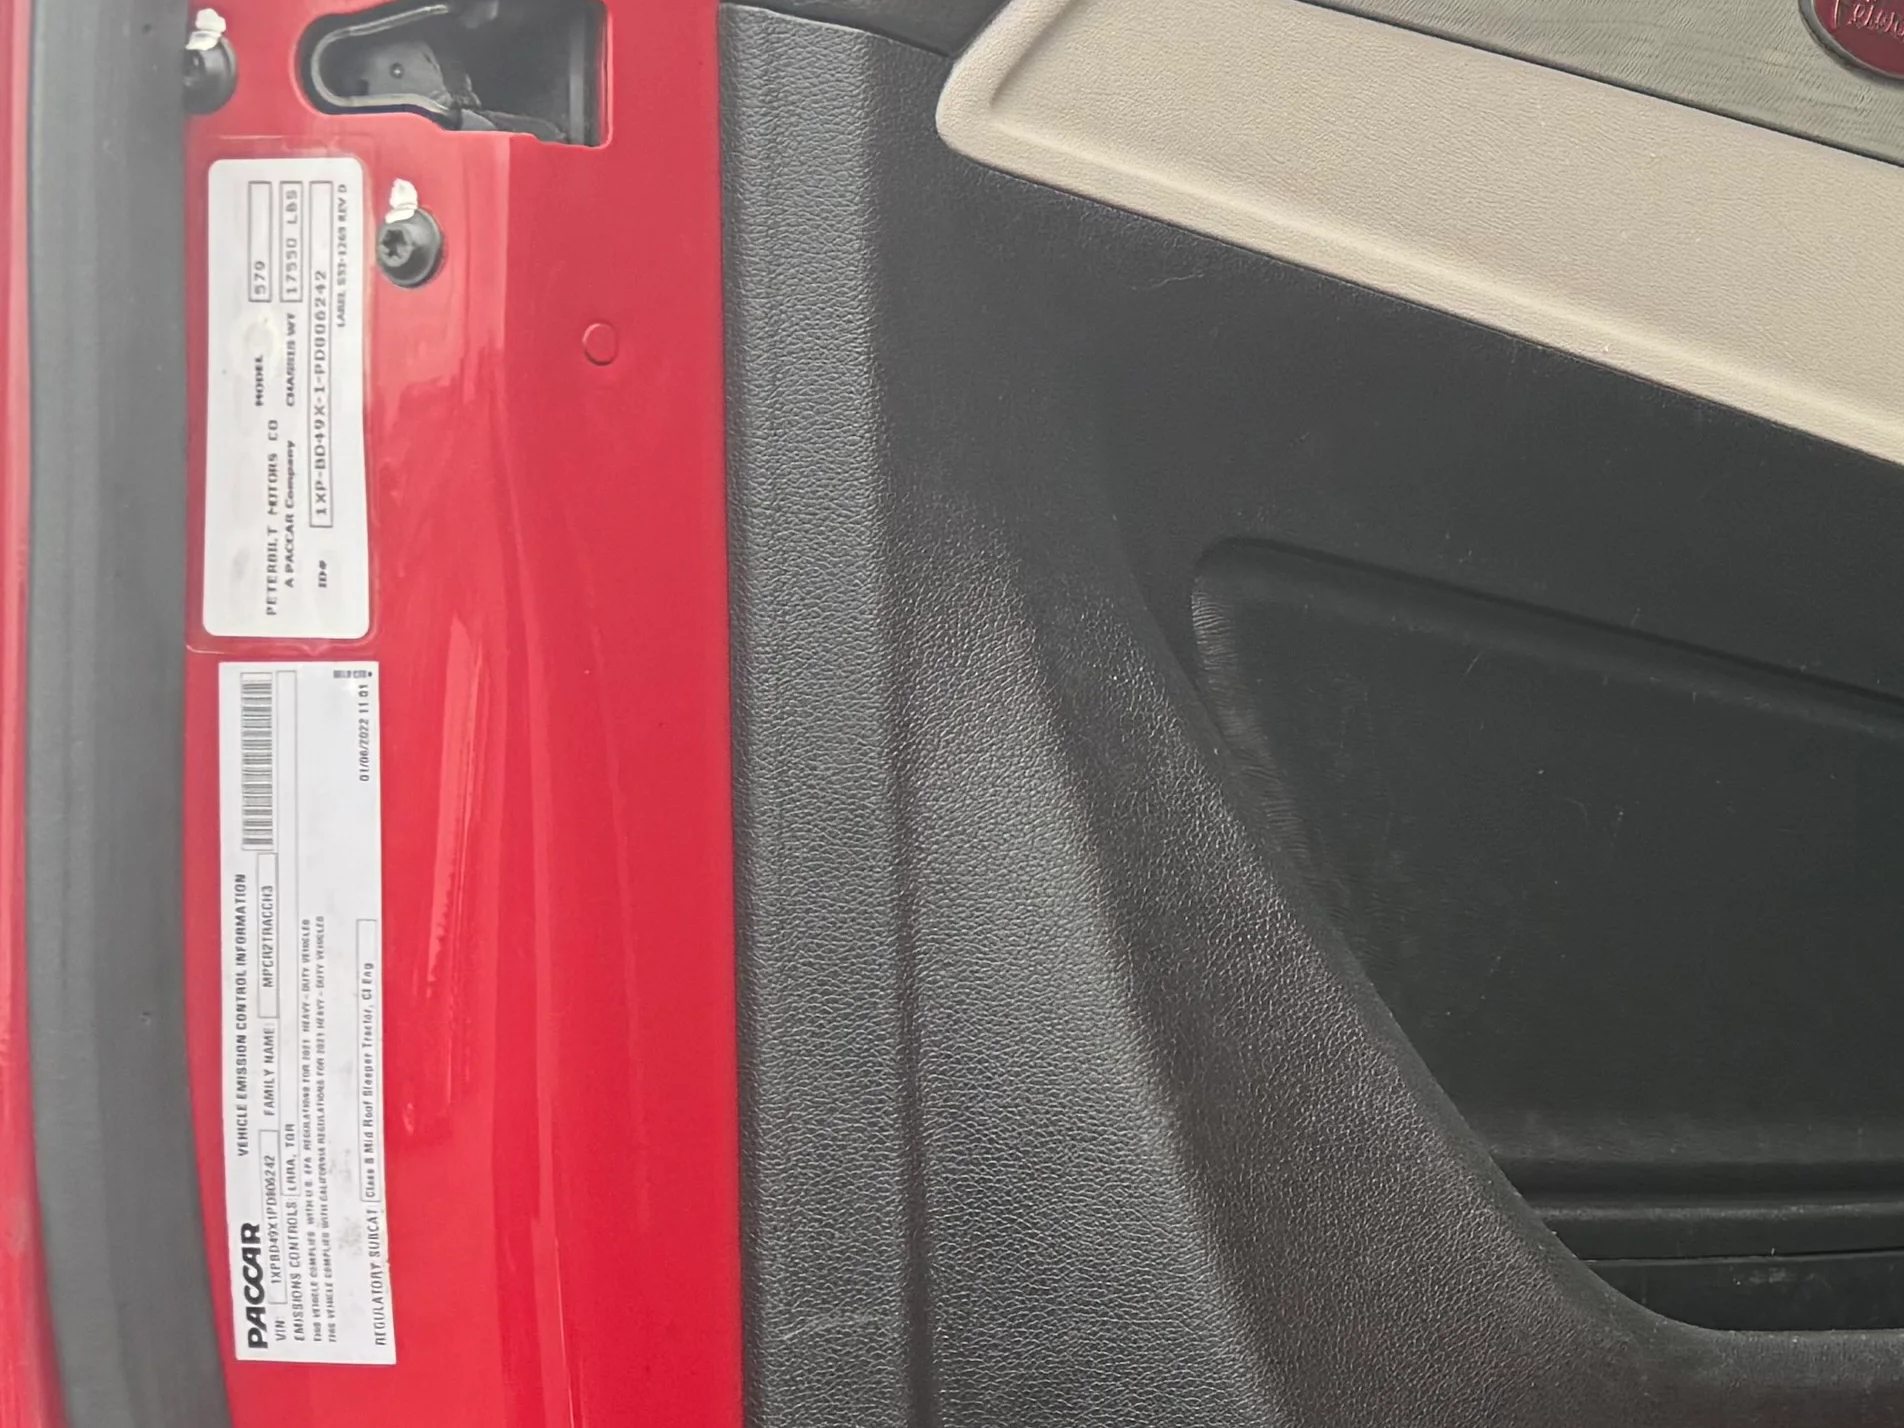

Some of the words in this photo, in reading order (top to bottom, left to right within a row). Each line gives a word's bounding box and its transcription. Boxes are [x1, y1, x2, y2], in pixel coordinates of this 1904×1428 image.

[336, 197, 347, 222] REV
[253, 260, 266, 295] 579
[286, 313, 296, 336] WT
[337, 290, 347, 328] LABEL
[254, 355, 264, 407] MODEL
[286, 340, 296, 407] CHASSIS
[267, 419, 279, 441] CO
[266, 452, 279, 515] MOTORS
[284, 440, 296, 509] Company
[284, 513, 295, 573] PACCAR
[266, 525, 279, 616] PETERBILT
[284, 577, 295, 588] A
[318, 560, 327, 588] ID#
[234, 874, 247, 966] INFORMATION
[301, 919, 310, 963] VEHICLES
[315, 916, 325, 960] VEHICLES
[301, 968, 310, 992] DUTY
[315, 964, 325, 988] DUTY
[361, 962, 374, 985] Eng
[235, 970, 247, 1030] CONTROL
[302, 1002, 310, 1032] HEAVY
[316, 999, 325, 1029] HEAVY
[235, 1034, 247, 1099] EMISSION
[302, 1065, 310, 1083] FOR
[316, 1058, 325, 1076] FOR
[362, 1053, 374, 1096] Sleeper
[263, 1069, 275, 1116] FAMILY
[316, 1080, 326, 1144] REGULATIONS
[362, 1101, 373, 1127] Roof
[236, 1104, 249, 1156] VEHICLE
[302, 1086, 312, 1151] REGULATIONS
[363, 1131, 374, 1153] Mid
[317, 1147, 328, 1201] CALIFORNIA
[364, 1168, 375, 1198] Class
[240, 1222, 269, 1349] PACCAR
[289, 1273, 306, 1341] EMISSIONS
[369, 1262, 387, 1346] REGULATORY
